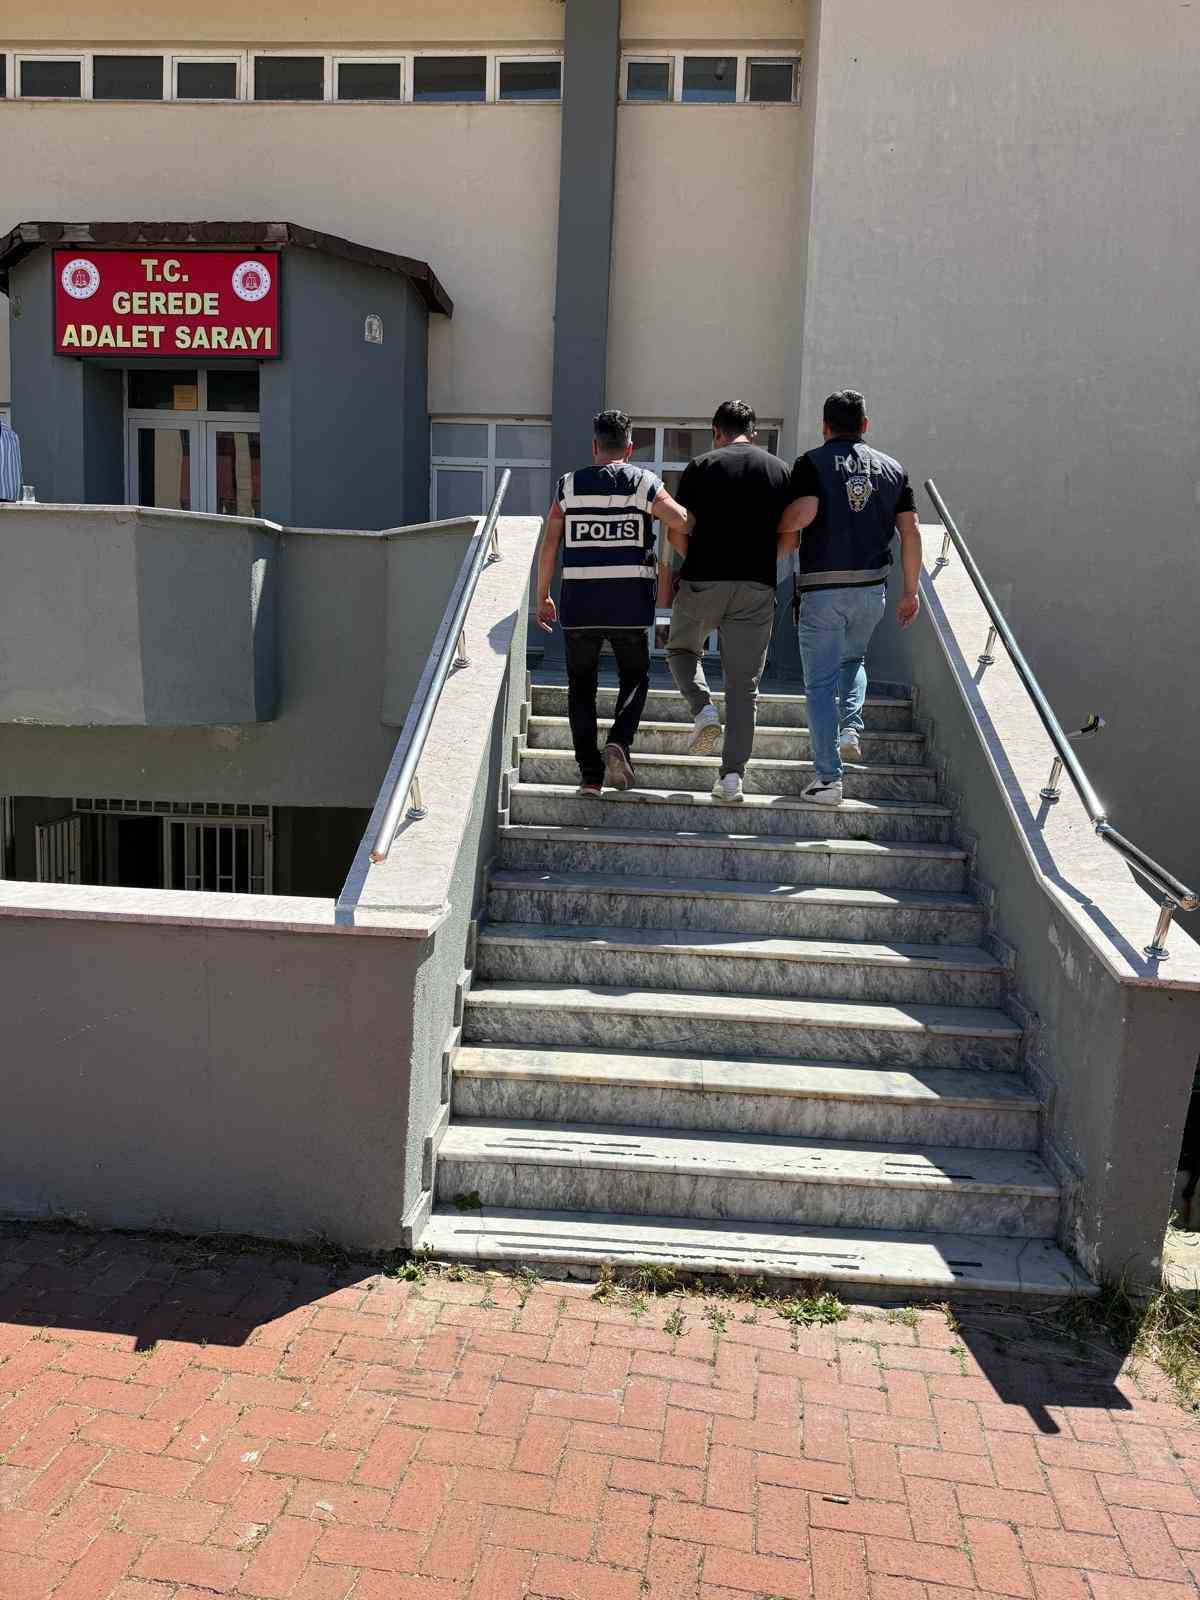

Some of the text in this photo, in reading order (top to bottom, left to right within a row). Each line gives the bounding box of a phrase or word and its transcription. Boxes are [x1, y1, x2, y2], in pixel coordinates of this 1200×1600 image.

[141, 259, 188, 281] T.C.
[112, 291, 219, 315] GEREDE
[62, 324, 272, 349] ADALET SARAYI
